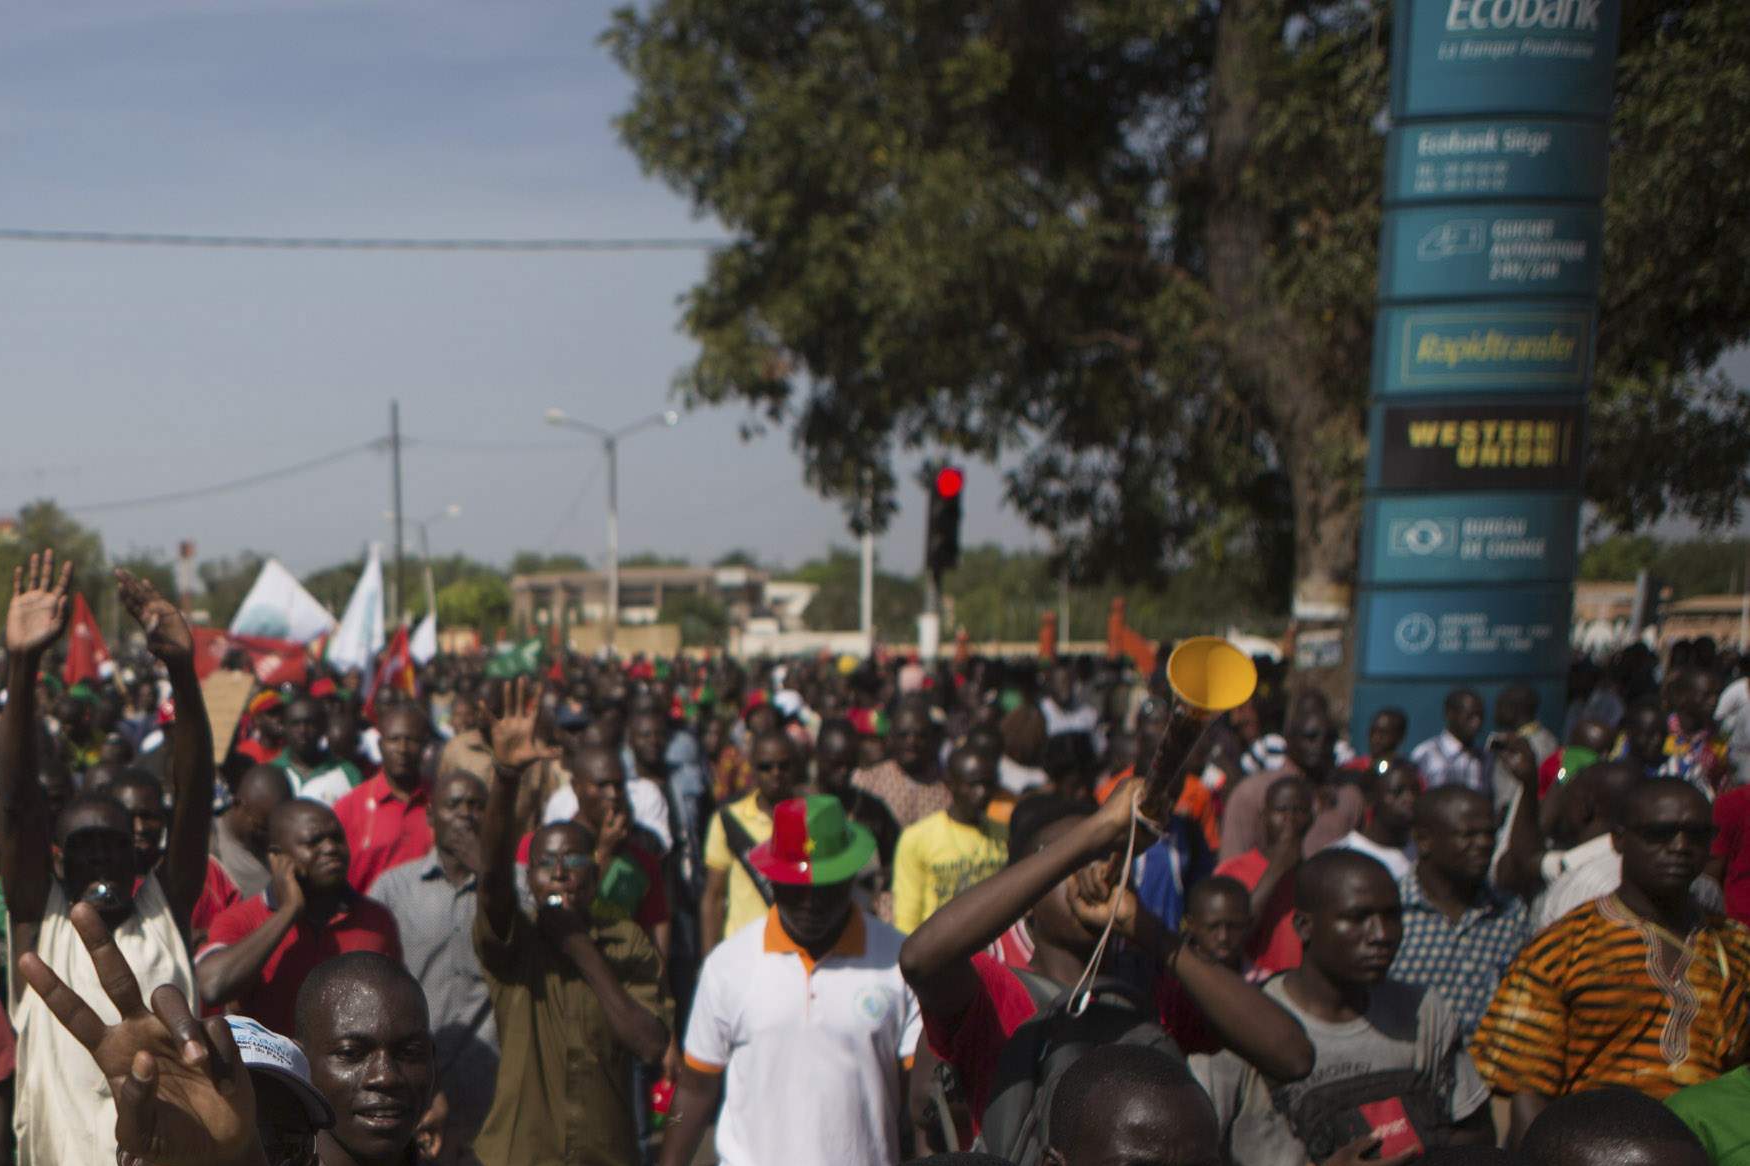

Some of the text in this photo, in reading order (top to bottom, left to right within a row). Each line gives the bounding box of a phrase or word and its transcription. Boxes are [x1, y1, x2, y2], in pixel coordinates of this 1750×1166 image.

[1446, 0, 1600, 32] Ecobank
[1407, 420, 1558, 448] WESTERN
[1456, 446, 1556, 468] UNION
